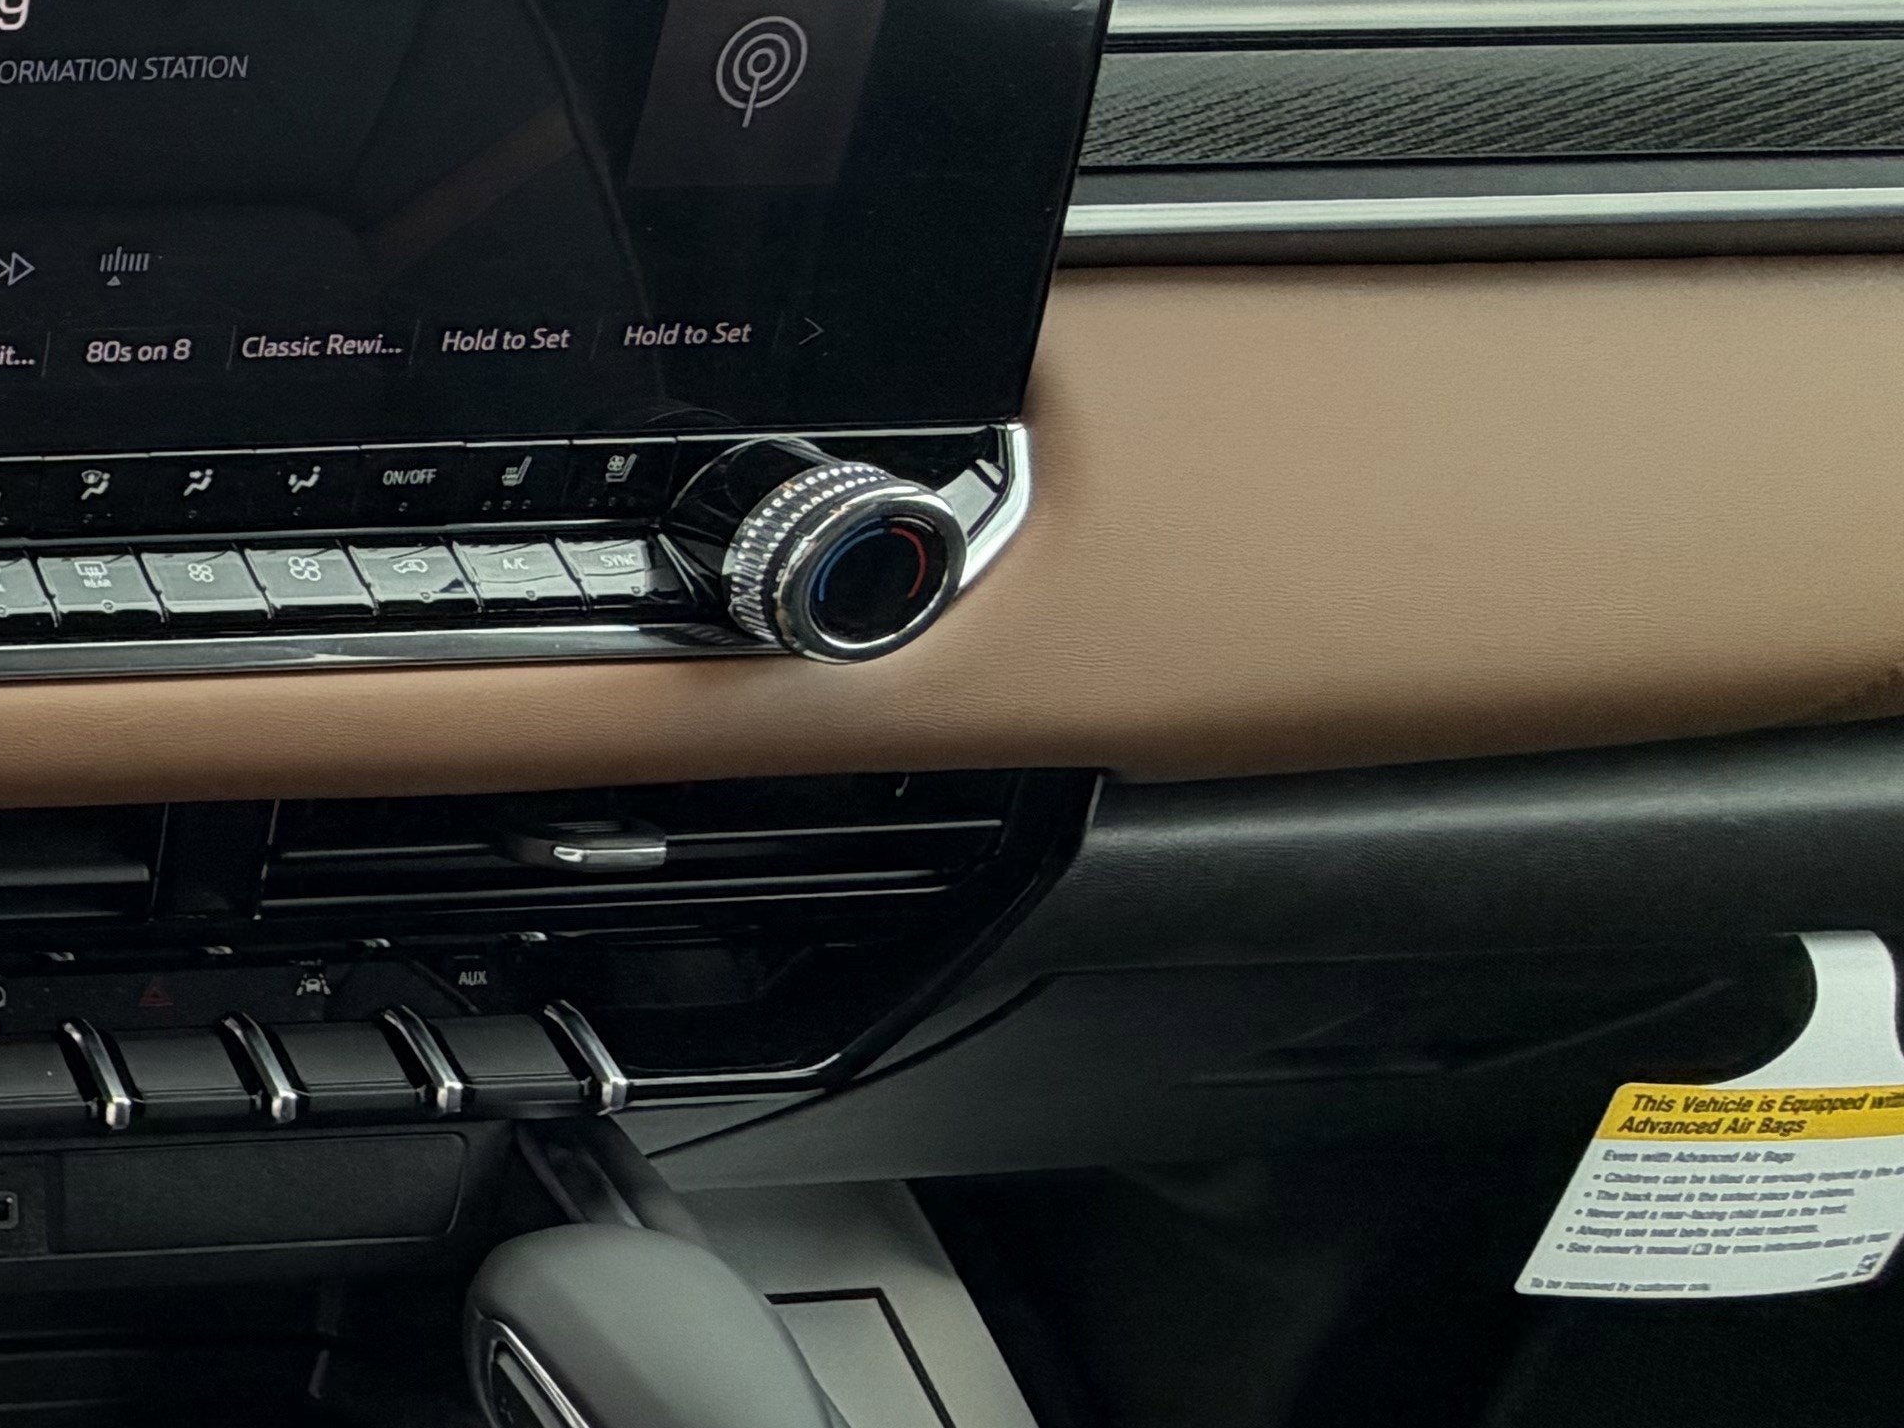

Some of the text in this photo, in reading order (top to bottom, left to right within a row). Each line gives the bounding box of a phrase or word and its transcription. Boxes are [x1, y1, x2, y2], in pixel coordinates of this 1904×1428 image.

[143, 54, 248, 82] STATION
[441, 326, 570, 353] Hold to Set
[624, 321, 751, 348] Hold to Set
[86, 337, 191, 363] 80s on 8
[242, 335, 320, 360] Classic
[382, 468, 437, 486] ON/OFF
[458, 970, 488, 986] AUX
[1632, 1094, 1676, 1112] This
[1681, 1096, 1754, 1113] Vehicle
[1757, 1096, 1776, 1112] is
[1779, 1094, 1869, 1115] Equipped
[1617, 1116, 1807, 1137] Advanced Air Bags
